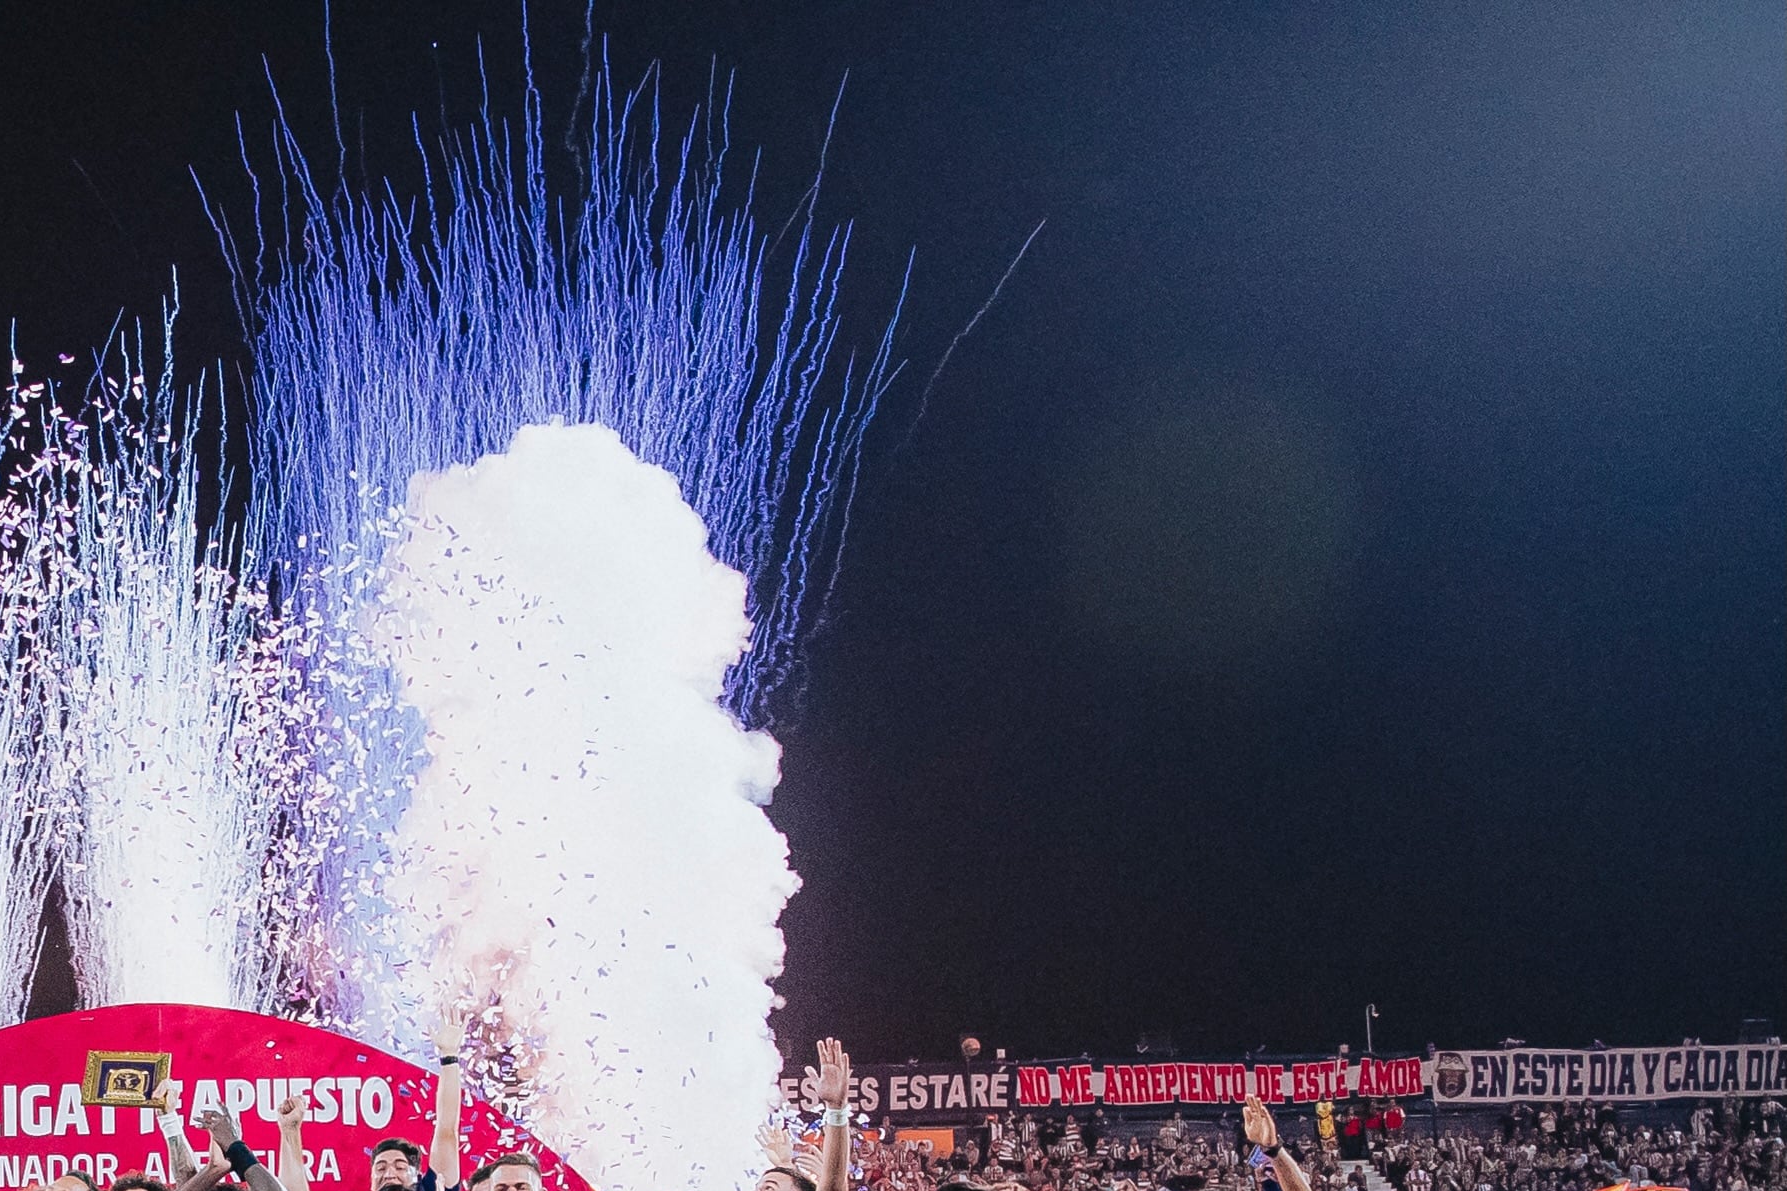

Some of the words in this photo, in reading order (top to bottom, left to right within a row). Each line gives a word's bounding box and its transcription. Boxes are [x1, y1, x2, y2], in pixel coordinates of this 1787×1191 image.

[890, 1066, 1009, 1111] ESTARÉ
[1017, 1066, 1051, 1106] NO
[1056, 1063, 1095, 1106] ME
[1103, 1063, 1246, 1105] ARREPIENTO
[1253, 1063, 1285, 1104] DE
[1358, 1056, 1424, 1098] AMOR
[1471, 1055, 1508, 1097] EN
[1513, 1053, 1584, 1096] ESTE
[1588, 1052, 1638, 1095] DIA
[1641, 1051, 1661, 1095] Y
[1663, 1050, 1741, 1093] CADA
